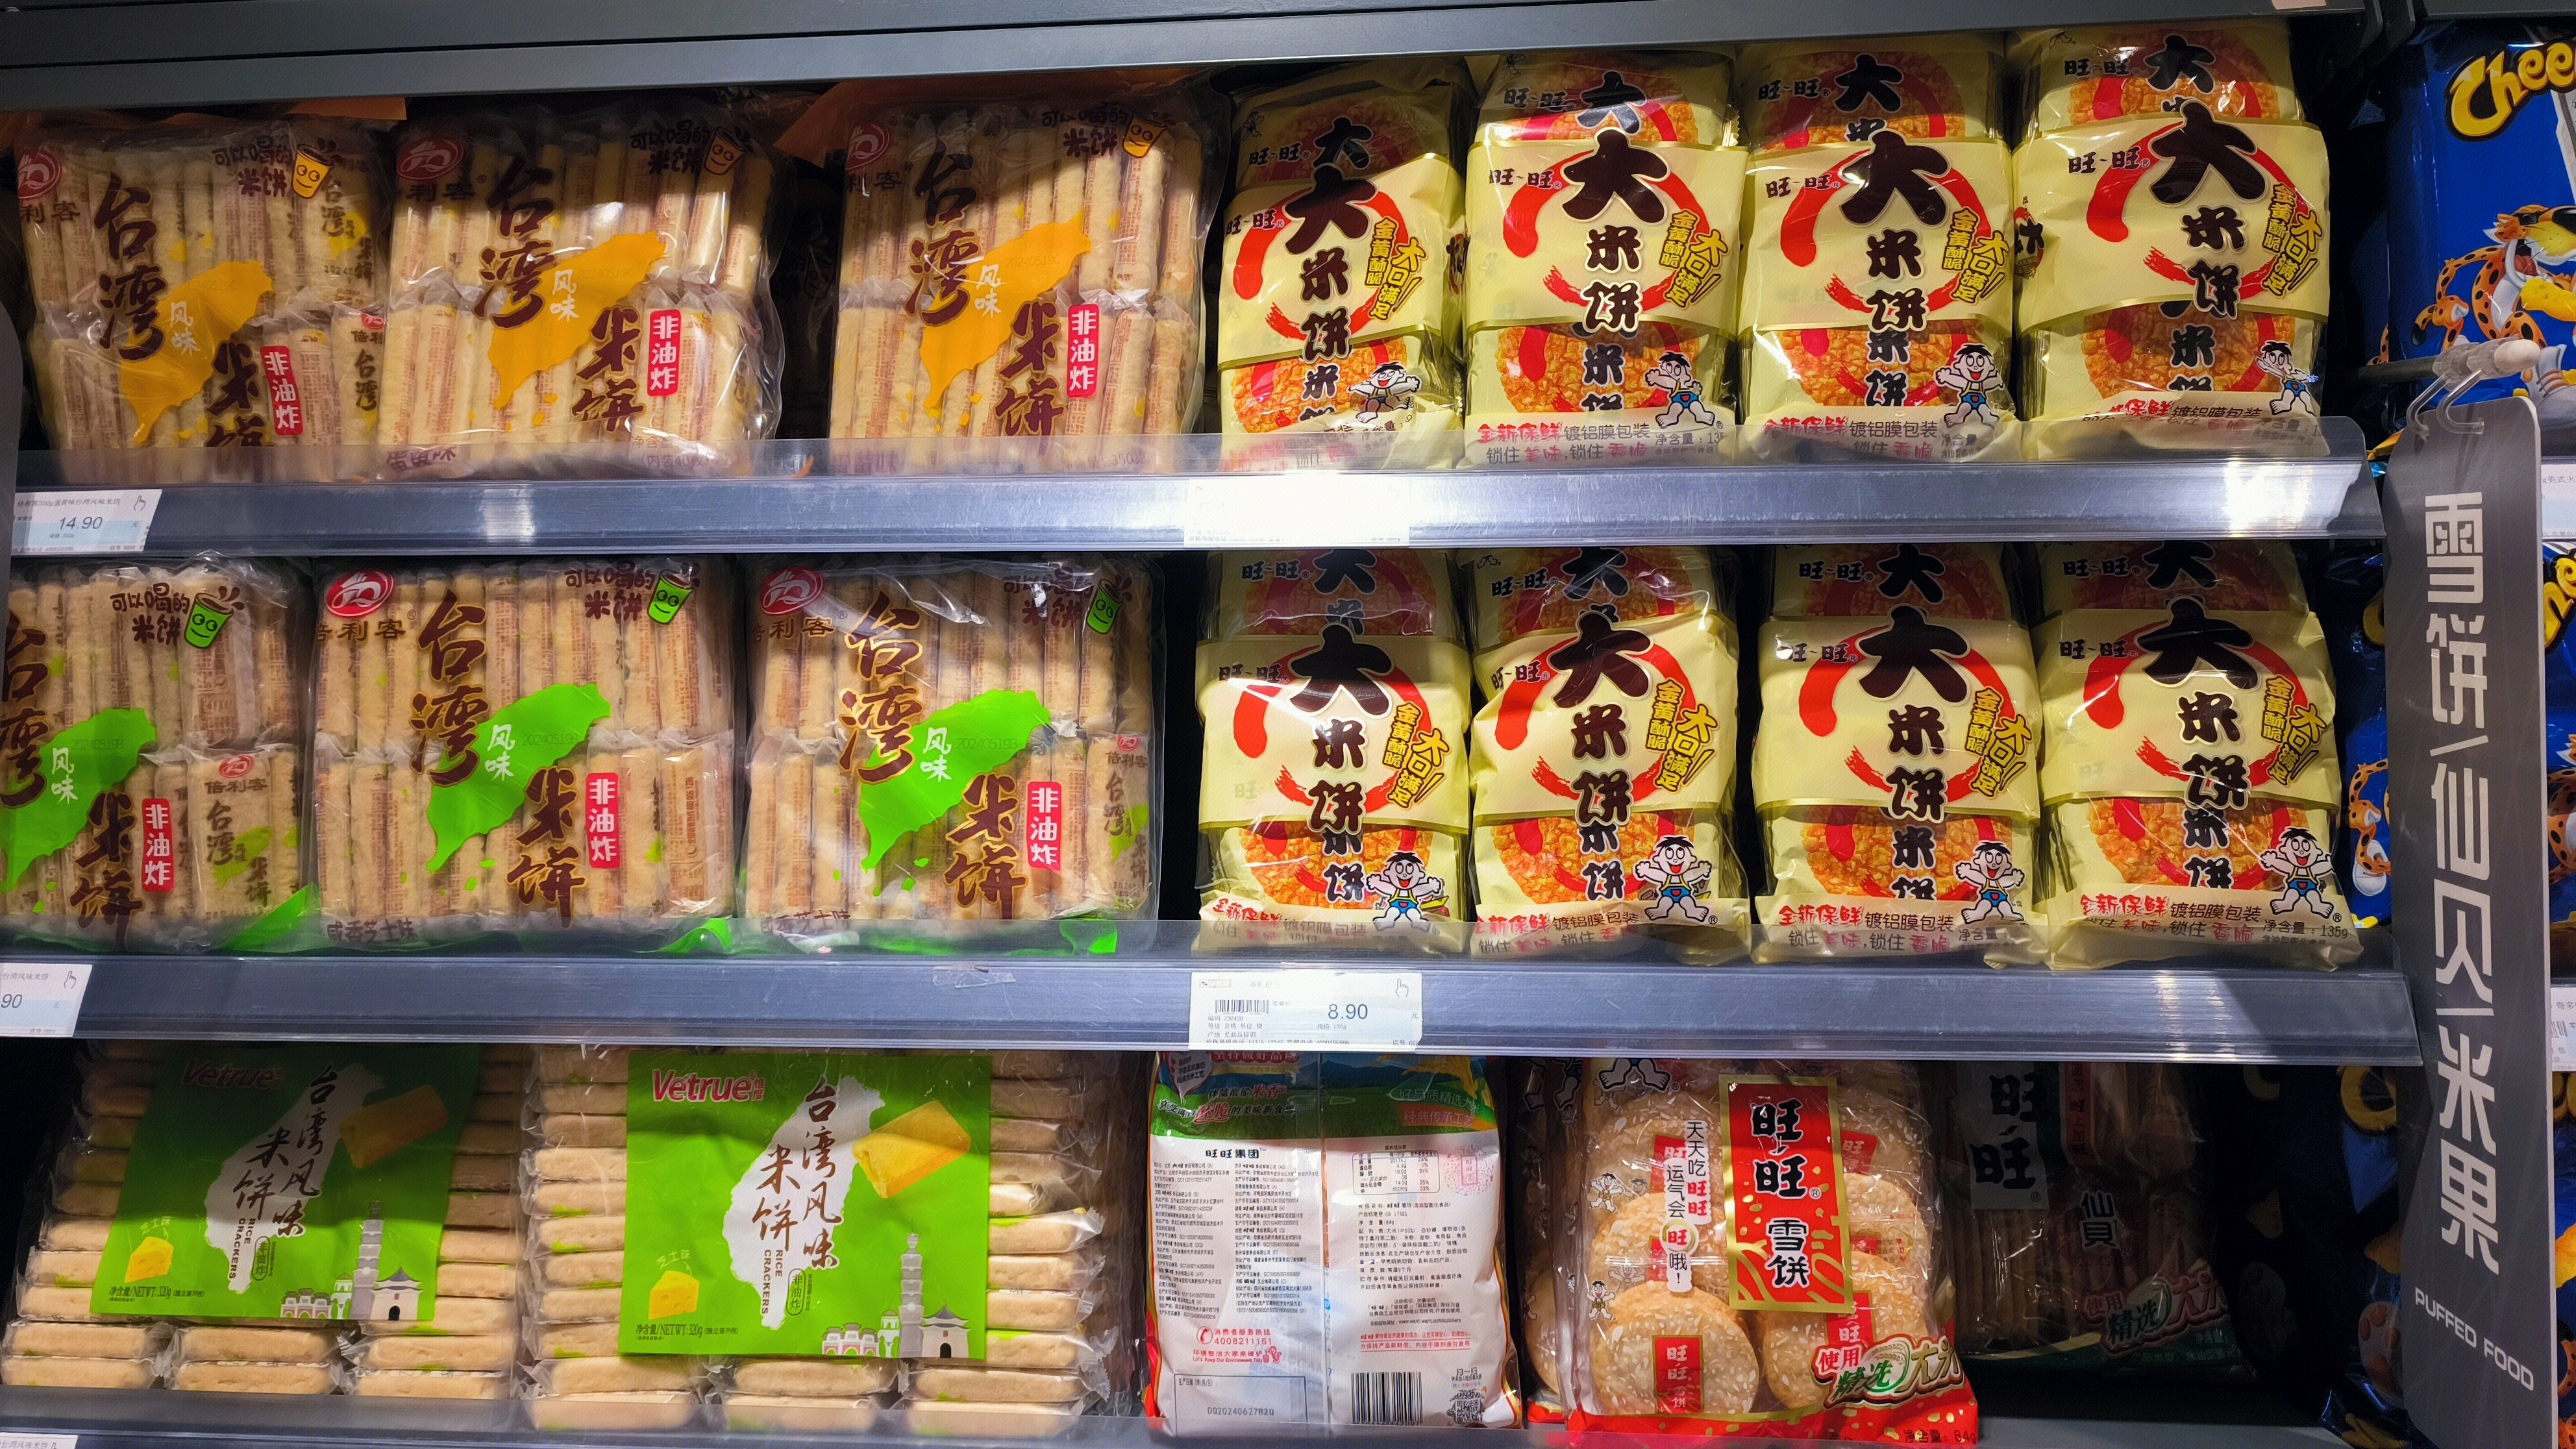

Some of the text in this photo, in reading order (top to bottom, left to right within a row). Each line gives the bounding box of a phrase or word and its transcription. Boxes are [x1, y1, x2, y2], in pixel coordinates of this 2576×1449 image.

[2447, 40, 2576, 137] Chee
[212, 138, 291, 164] 可以喝的
[649, 148, 701, 173] 米饼
[1062, 129, 1119, 158] 米饼
[238, 171, 287, 197] 米饼
[473, 158, 556, 329] 台湾
[906, 138, 982, 325] 台湾
[1660, 210, 1699, 269] 金黄酥脆
[1942, 208, 1978, 271] 金黄酥脆
[2262, 183, 2296, 252] 金黄酥脆
[93, 173, 166, 361] 台湾
[1365, 218, 1395, 288] 金黄酥脆
[551, 270, 580, 323] 风味
[975, 264, 1002, 317] 风味
[171, 301, 201, 356] 风味
[650, 315, 676, 391] 非油炸
[1069, 310, 1097, 393] 非油炸
[265, 352, 299, 428] 非油炸
[572, 306, 644, 431] 米饼
[995, 301, 1063, 452] 米饼
[1478, 422, 1650, 443] 全新保鲜 镀铝膜包装
[1850, 421, 1938, 438] 镀铝膜包装
[60, 517, 103, 530] 14.90
[110, 583, 190, 613] 可以喝的
[565, 562, 656, 589] 可以喝的
[584, 593, 641, 621] 米饼
[132, 615, 180, 646] 米饼
[410, 589, 488, 786] 台湾
[838, 591, 923, 784] 台湾
[1646, 680, 1685, 751] 金黄酥脆
[2262, 675, 2294, 743] 金黄酥脆
[485, 725, 515, 780] 风味
[1382, 702, 1422, 769] 金黄酥脆
[1966, 687, 2003, 755] 金黄酥脆
[51, 747, 78, 804] 风味
[921, 726, 952, 782] 风味
[145, 804, 173, 886] 非油炸
[206, 800, 234, 866] 台湾
[506, 768, 586, 928] 米饼
[589, 778, 617, 861] 非油炸
[945, 773, 1028, 919] 米饼
[1031, 787, 1058, 865] 非油炸
[70, 792, 143, 950] 米饼
[1552, 911, 1639, 931] 镀铝膜包装
[1778, 905, 1955, 932] 全新保鲜 镀铝膜包装
[2081, 893, 2262, 922] 全新保鲜 镀铝膜包装
[1328, 1003, 1368, 1020] 8.90
[181, 1058, 275, 1089] Vetrue
[652, 1070, 752, 1102] Vetrue
[1404, 1111, 1473, 1127] 经典传承工艺
[232, 1127, 290, 1220] 米饼
[752, 1144, 800, 1252] 米饼
[802, 1074, 843, 1269] 台湾风味
[229, 1218, 245, 1279] CRACKERS
[244, 1218, 256, 1244] RICE
[656, 1250, 691, 1267] 芝士味
[1766, 1219, 1810, 1288] 雪饼
[762, 1250, 772, 1314] CRACKERS
[789, 1273, 802, 1310] 非油炸
[1816, 1350, 1860, 1372] 使用
[2414, 1287, 2534, 1392] PUFFED FOOD
